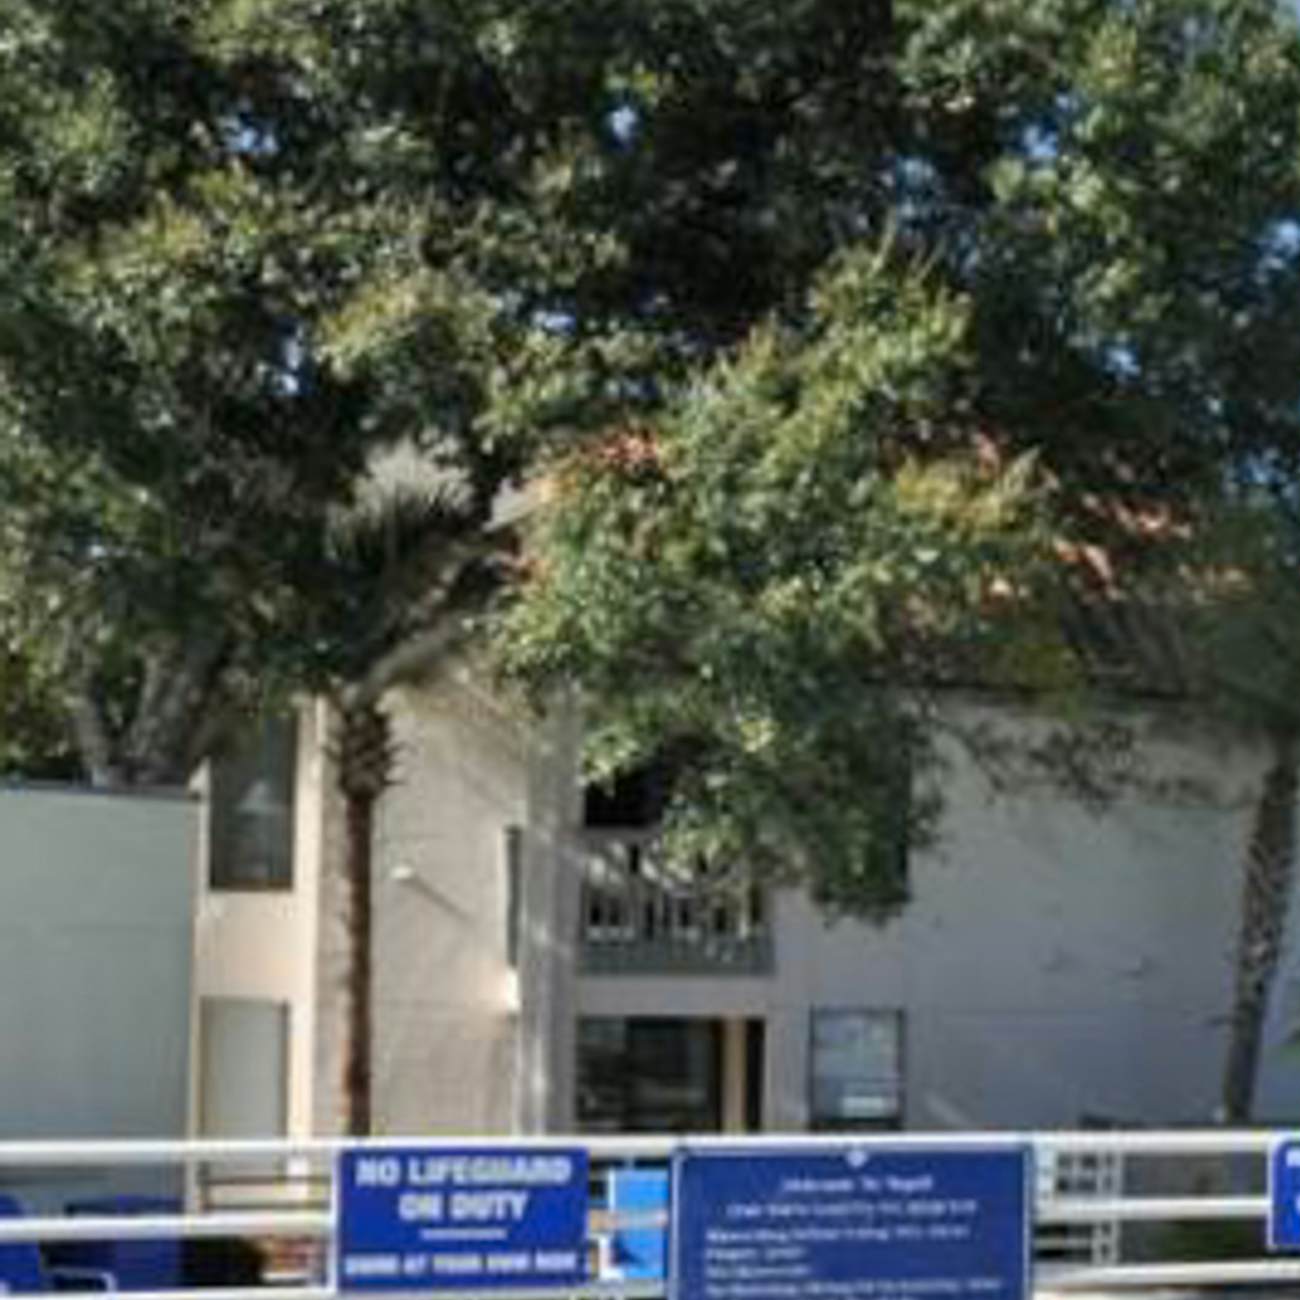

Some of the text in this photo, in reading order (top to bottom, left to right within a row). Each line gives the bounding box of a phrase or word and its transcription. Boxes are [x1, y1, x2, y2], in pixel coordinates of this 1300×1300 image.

[355, 1156, 572, 1186] NO LIFEGUARD
[398, 1191, 529, 1221] ON DUTY
